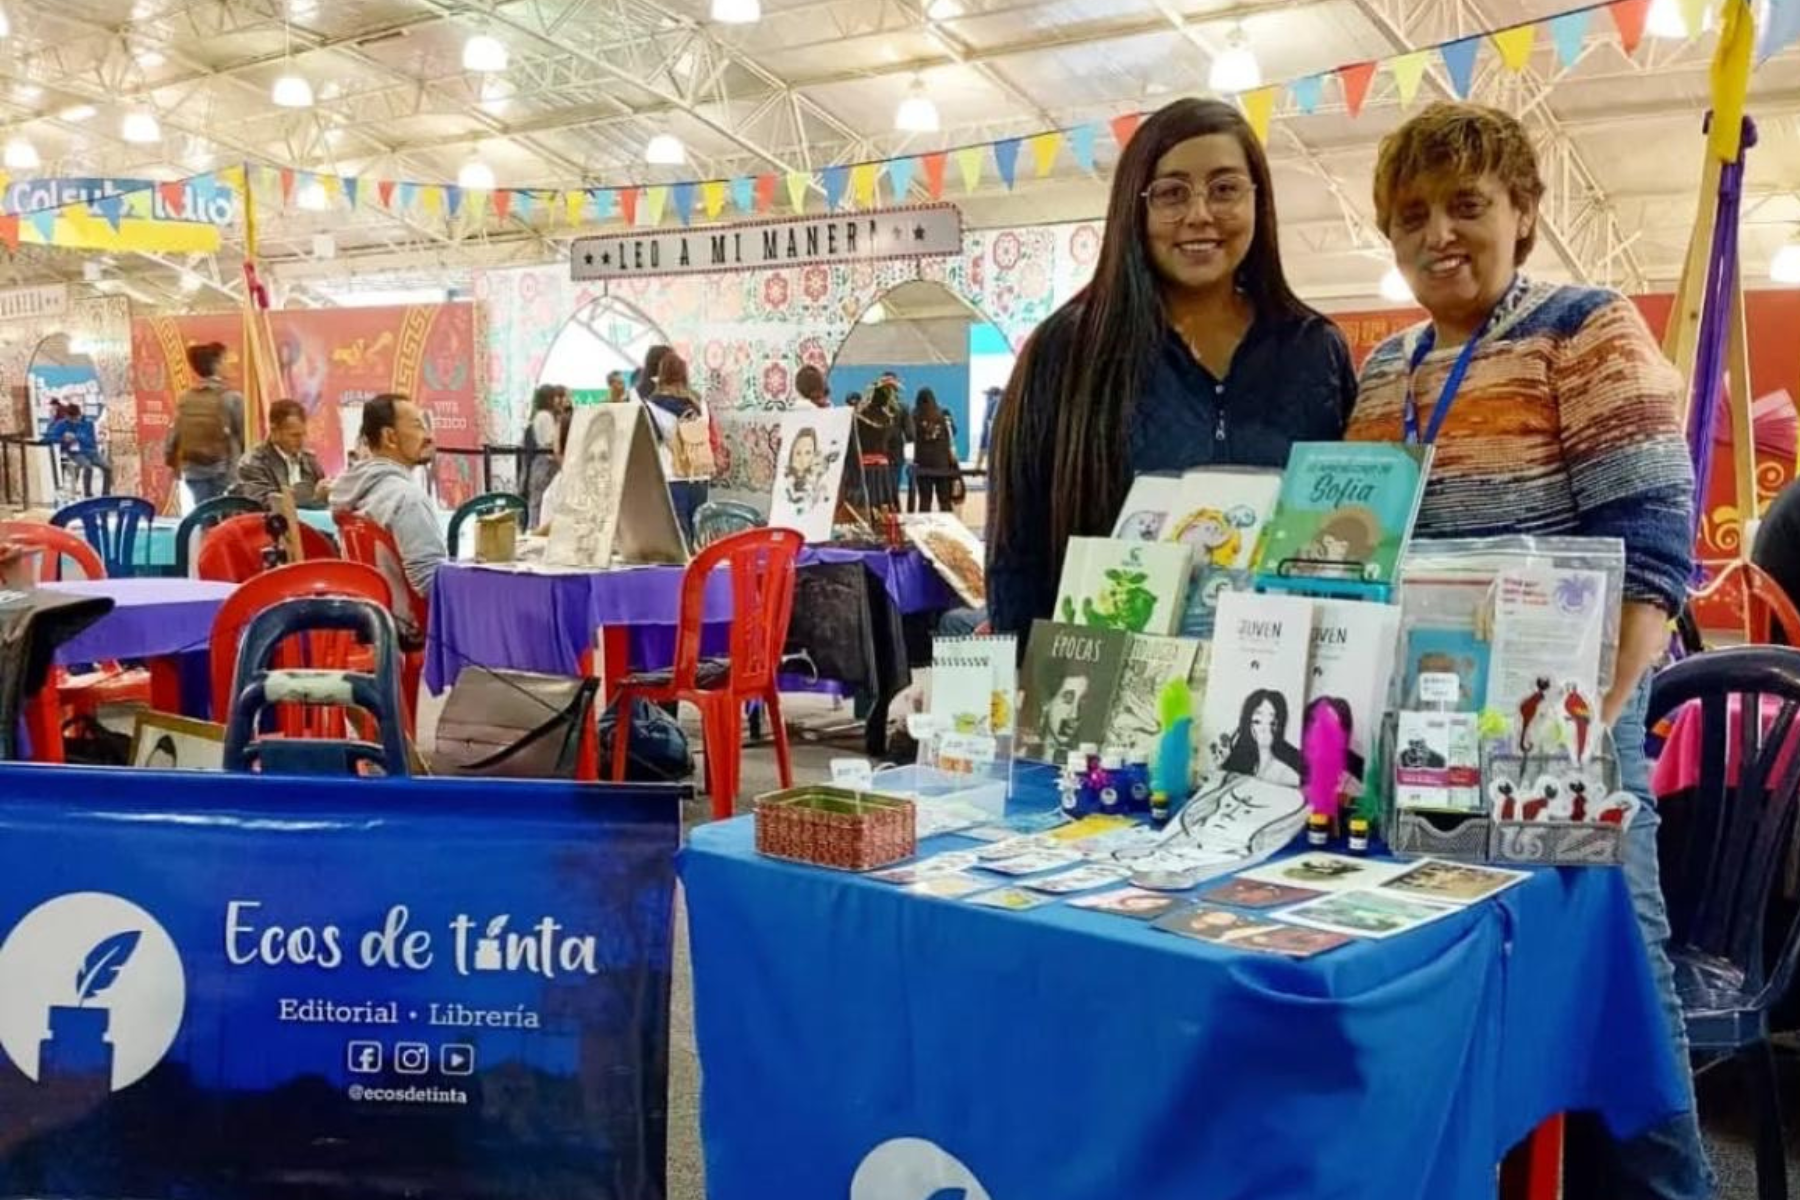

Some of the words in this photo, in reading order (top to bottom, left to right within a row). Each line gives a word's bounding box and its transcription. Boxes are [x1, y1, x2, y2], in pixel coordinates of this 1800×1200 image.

[618, 240, 659, 270] LEO
[679, 237, 690, 266] A
[711, 232, 742, 264] MI
[225, 900, 342, 968] Ecos
[360, 904, 433, 970] de
[278, 999, 398, 1024] Editorial
[429, 1003, 541, 1029] Librería
[348, 1084, 468, 1105] @ecosdetinta
